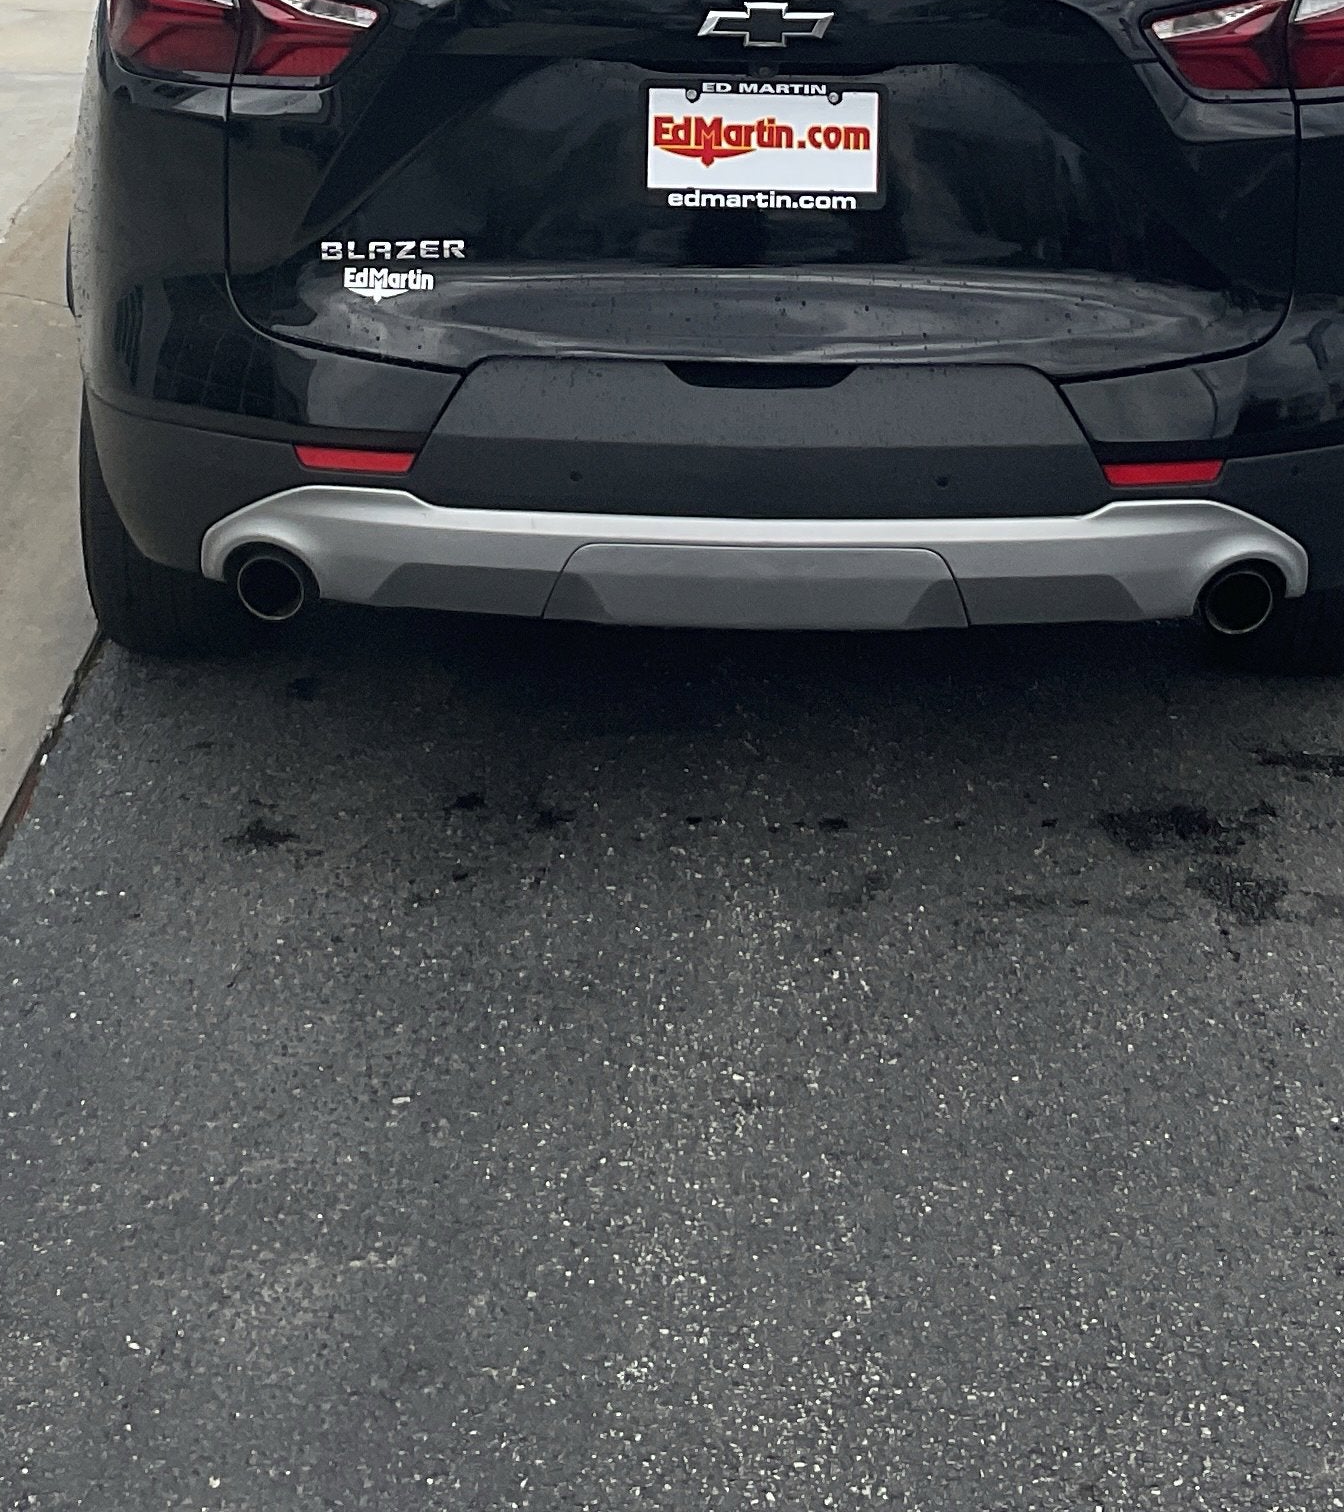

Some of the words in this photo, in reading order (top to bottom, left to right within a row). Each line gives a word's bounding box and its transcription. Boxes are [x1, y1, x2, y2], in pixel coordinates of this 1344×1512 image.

[702, 82, 732, 93] ED
[739, 83, 827, 95] MARTIN
[653, 116, 871, 151] EdMartin.com
[667, 190, 856, 209] edmartin.com
[321, 240, 465, 260] BLAZER
[343, 267, 435, 290] EdMartin
